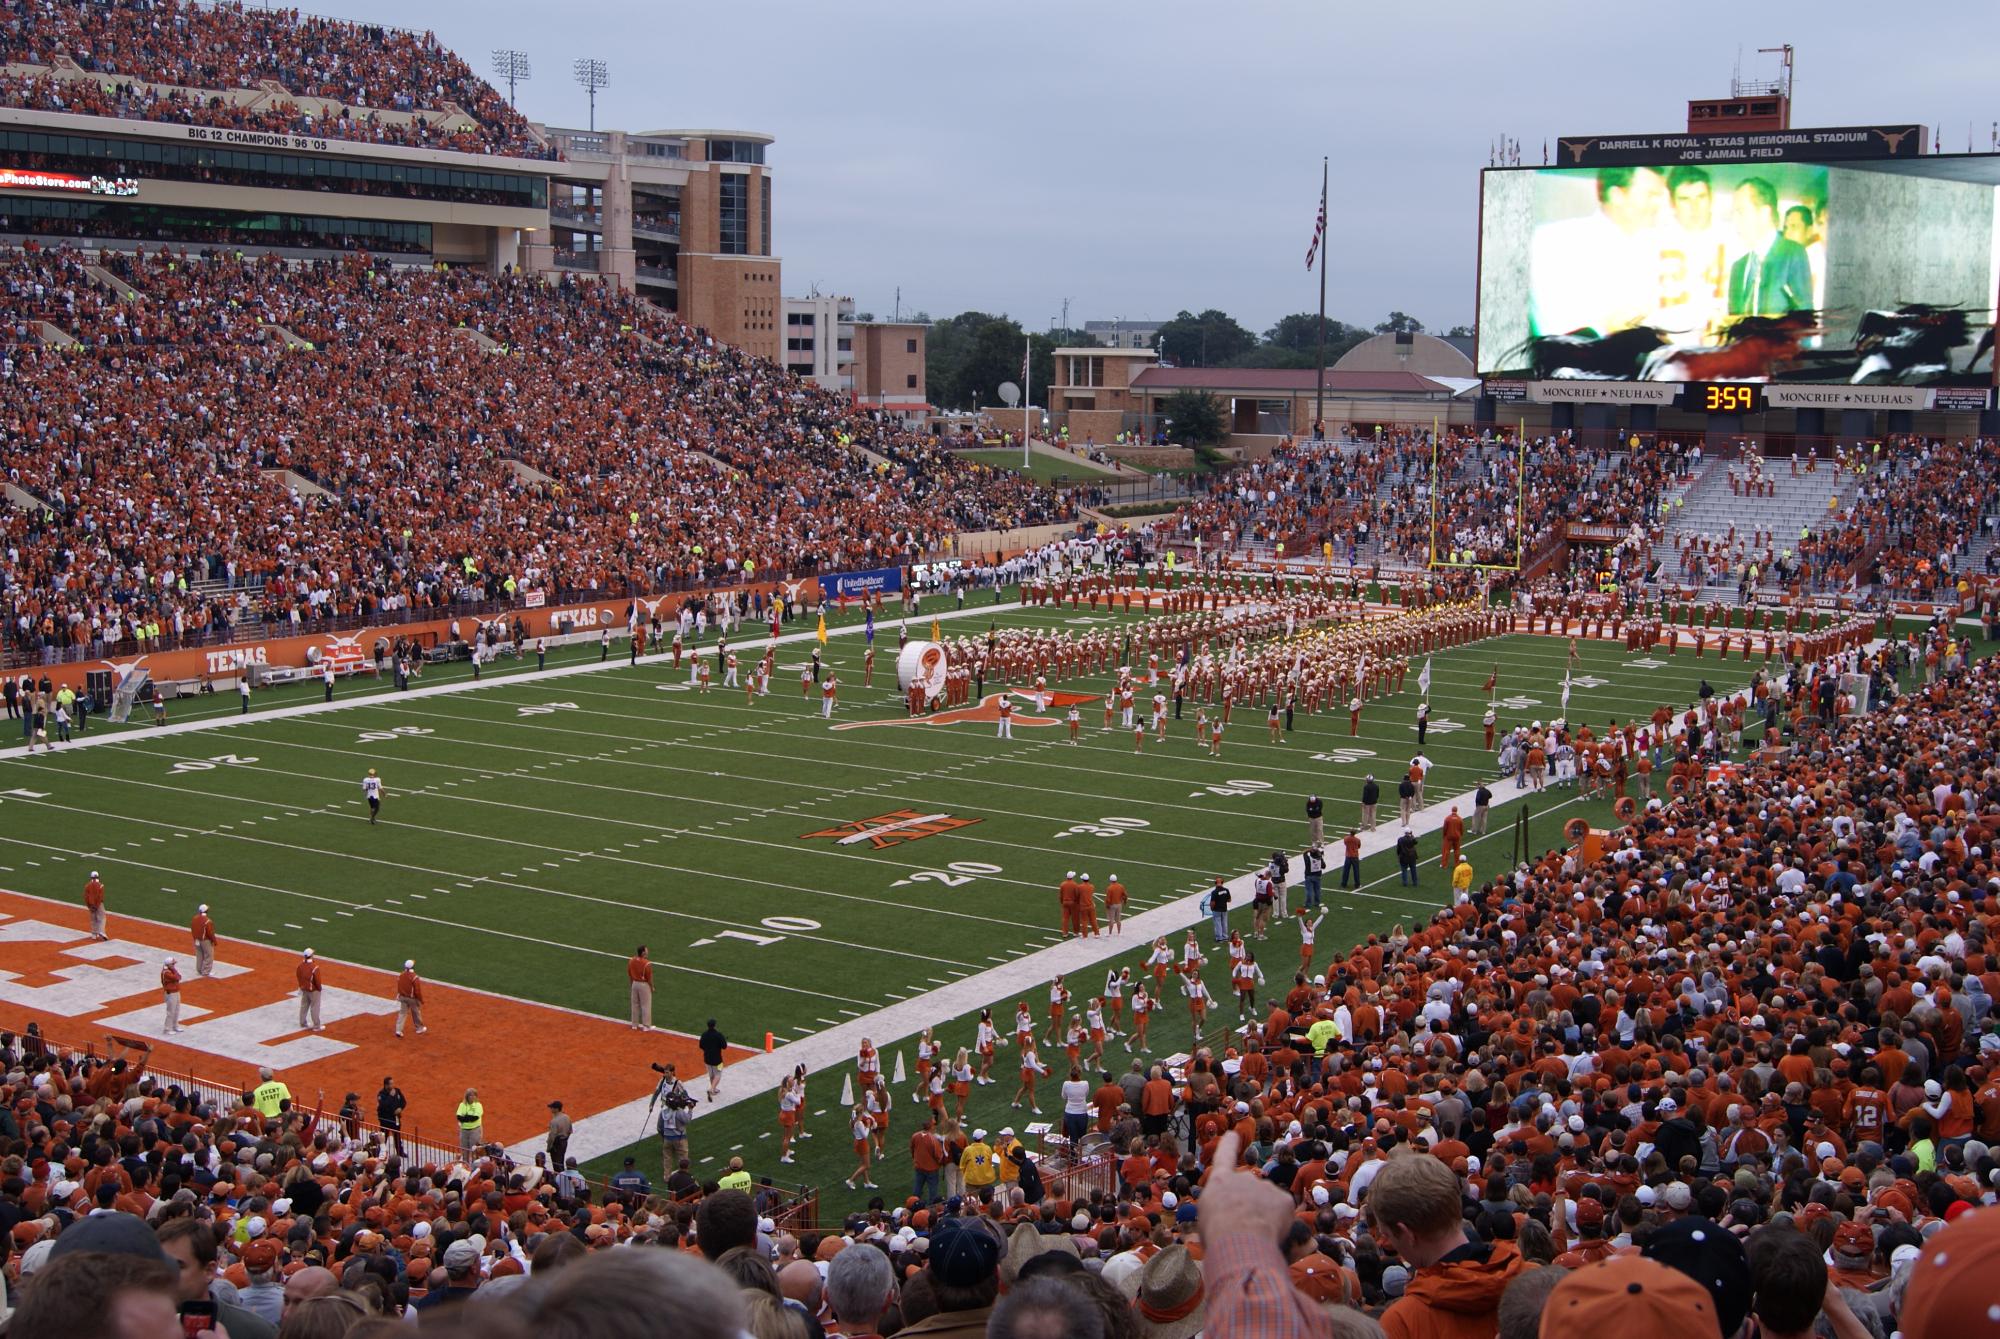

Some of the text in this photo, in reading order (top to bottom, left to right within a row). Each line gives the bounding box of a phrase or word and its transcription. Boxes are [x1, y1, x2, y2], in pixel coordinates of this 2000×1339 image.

[188, 128, 327, 150] BIG 12 CHAMPIONS '96 '05
[1599, 139, 1649, 150] DARRELL
[1652, 139, 1661, 149] K
[1663, 138, 1700, 149] ROYAL
[1708, 136, 1745, 147] TEXAS
[1748, 134, 1811, 146] MEMORIAL
[1813, 132, 1868, 143] STADIUM
[1679, 148, 1784, 160] JOE JAMAIL FIELD
[1542, 387, 1664, 399] MONCRIEF NEUHAUS
[1706, 387, 1751, 410] 3:59
[1779, 392, 1913, 404] MONCRIEF NEUHAUS
[1569, 525, 1584, 535] JOE
[1585, 526, 1615, 537] JAMAIL
[1286, 565, 1305, 573] TEXAS
[1331, 567, 1350, 576] TEXAS
[1378, 570, 1398, 579] TEXAS
[844, 576, 885, 588] UnitedHealthcare
[1757, 594, 1781, 602] TEXAS
[206, 646, 267, 673] TEXAS
[1309, 748, 1377, 763] 50
[173, 753, 260, 772] 20
[1205, 779, 1274, 797] 40
[1068, 816, 1150, 837] 30
[909, 862, 1004, 887] 20
[713, 916, 822, 946] 10
[260, 1087, 281, 1096] EVENT
[262, 1093, 280, 1102] STAFF
[1855, 1105, 1877, 1127] 12
[732, 1180, 750, 1189] EVENT
